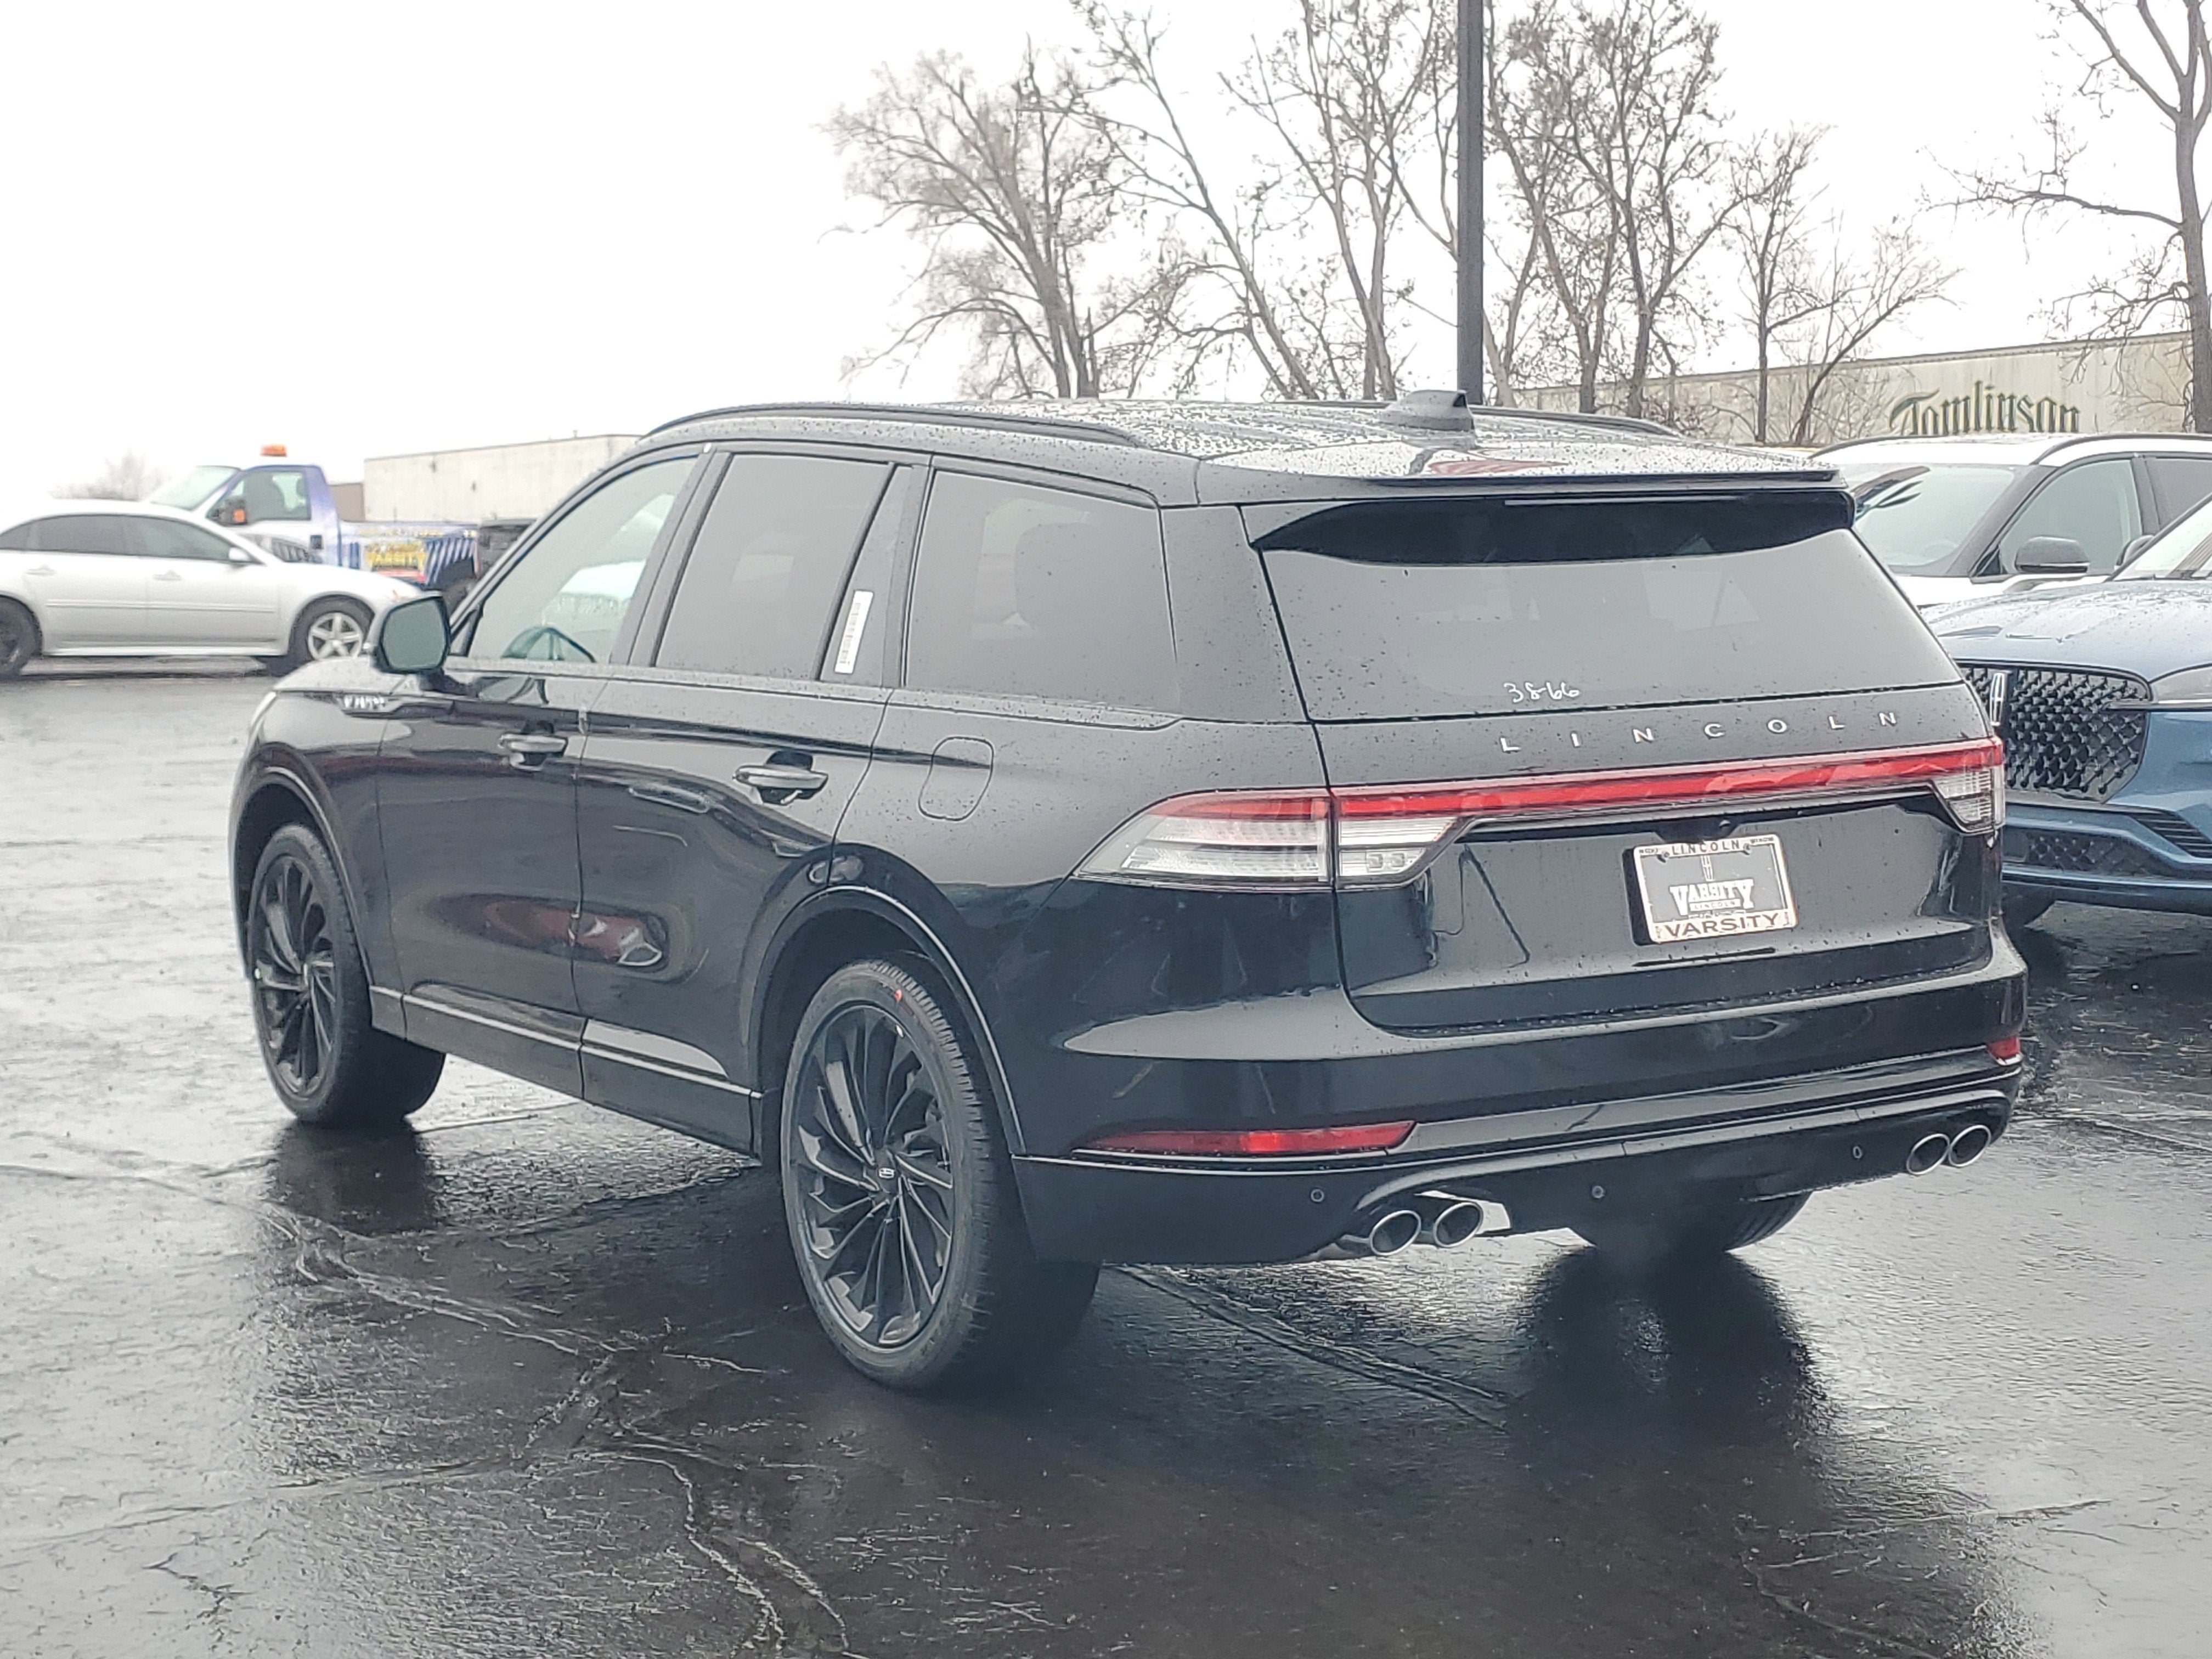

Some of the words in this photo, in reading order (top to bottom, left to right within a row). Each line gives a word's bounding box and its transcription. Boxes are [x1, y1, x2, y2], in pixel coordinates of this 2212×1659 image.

[1889, 380, 2081, 436] Tomlinson
[1503, 681, 1580, 703] 3866
[1500, 712, 1897, 752] LINCOLN
[1672, 840, 1740, 856] LINCOLN
[1669, 878, 1754, 916] VARSITY
[1663, 912, 1779, 937] VARSITY
